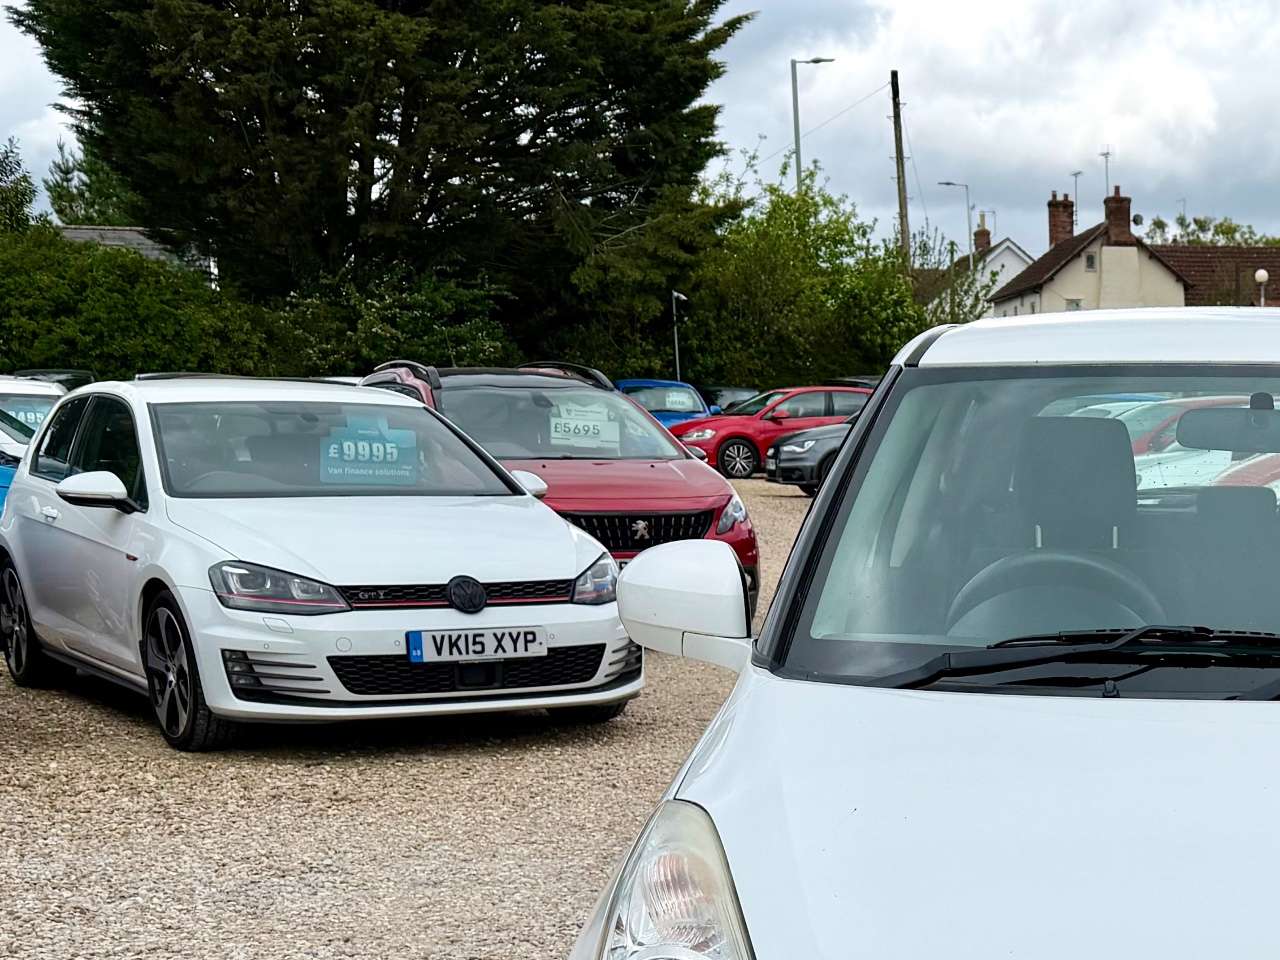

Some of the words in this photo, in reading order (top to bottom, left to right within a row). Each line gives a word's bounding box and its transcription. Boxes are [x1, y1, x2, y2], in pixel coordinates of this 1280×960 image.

[553, 421, 601, 436] £5695
[431, 632, 486, 657] VK15
[493, 630, 537, 654] XYP
